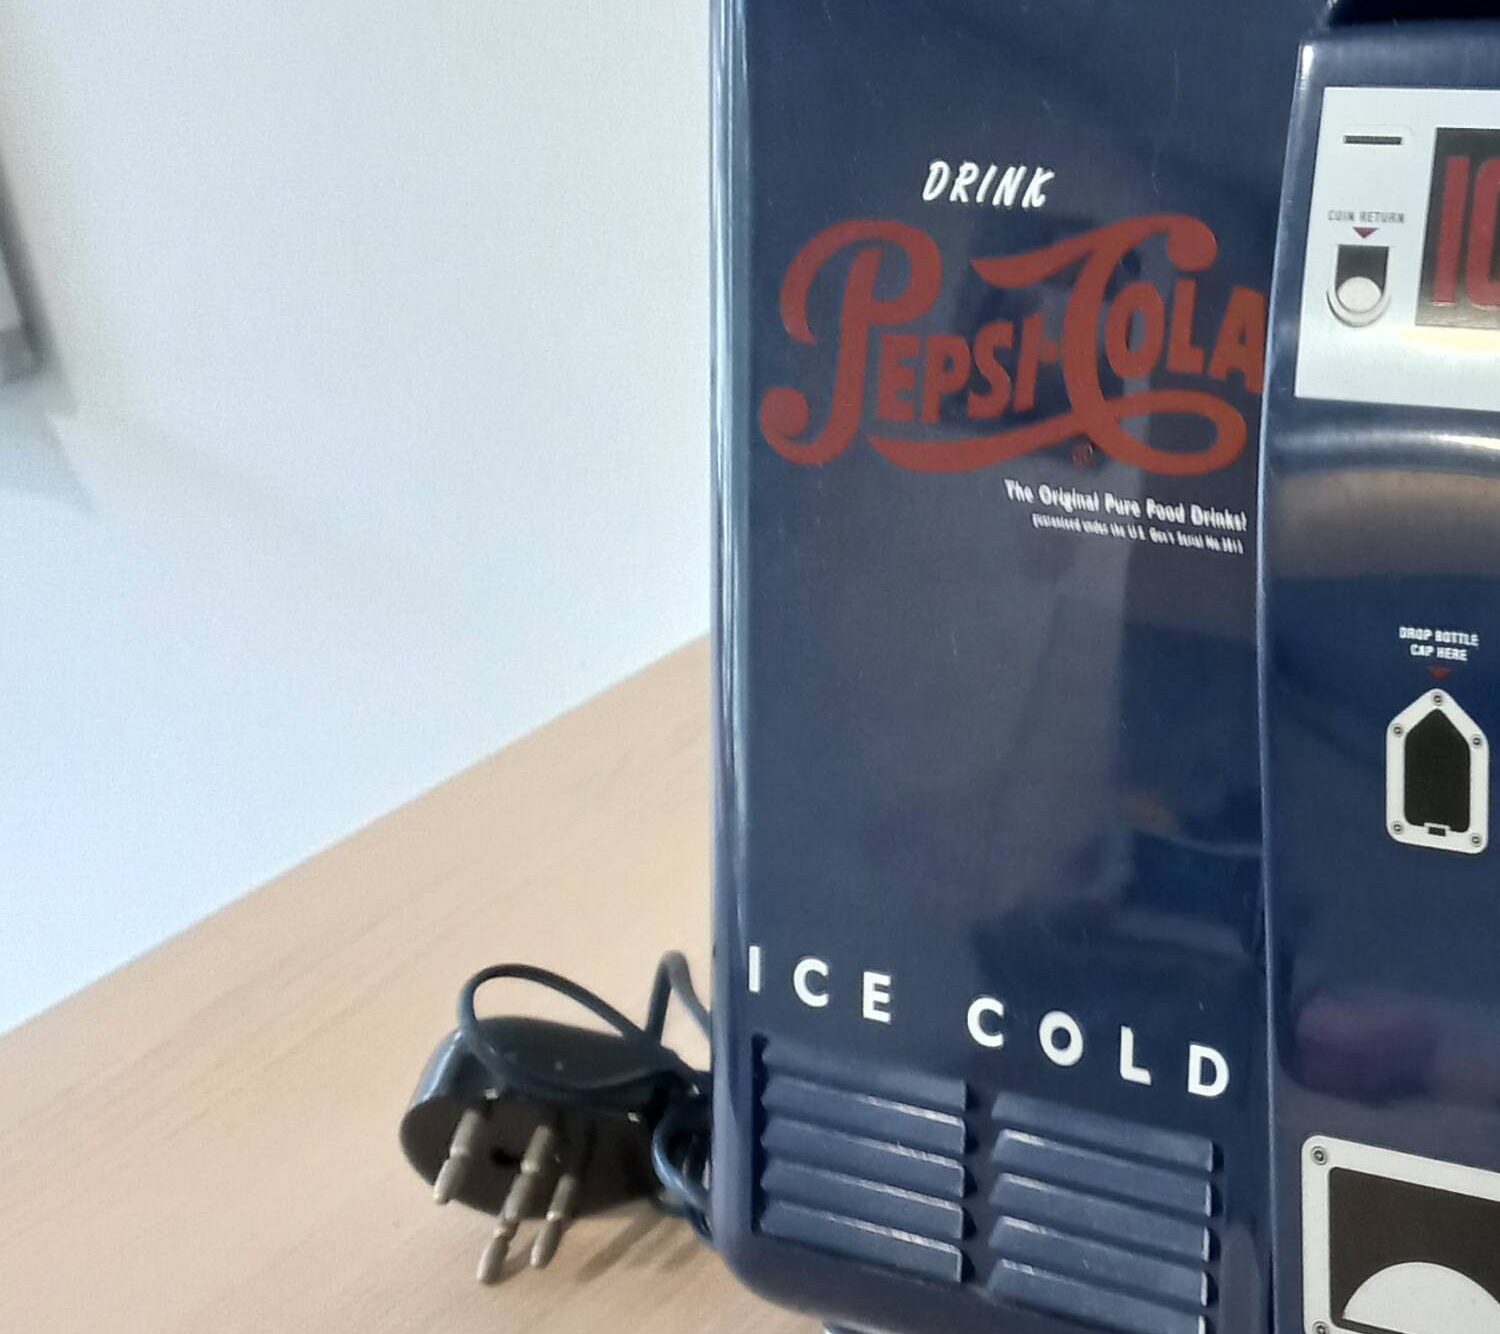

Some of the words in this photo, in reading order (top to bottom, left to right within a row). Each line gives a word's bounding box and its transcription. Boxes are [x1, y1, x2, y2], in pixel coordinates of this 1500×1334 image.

[922, 161, 1055, 208] DRINK
[1328, 210, 1354, 222] COIN
[1360, 211, 1404, 224] RETURN
[1004, 478, 1034, 504] The
[1038, 484, 1100, 512] Original
[1105, 492, 1141, 518] Pure
[1147, 498, 1185, 524] Food
[1191, 504, 1247, 532] Drinks!
[1399, 626, 1432, 641] DROP
[1435, 630, 1479, 647] BOTTLE
[1410, 643, 1434, 656] CAP
[1437, 647, 1468, 661] HERE
[748, 945, 891, 1023] ICE
[967, 996, 1230, 1097] COLD
